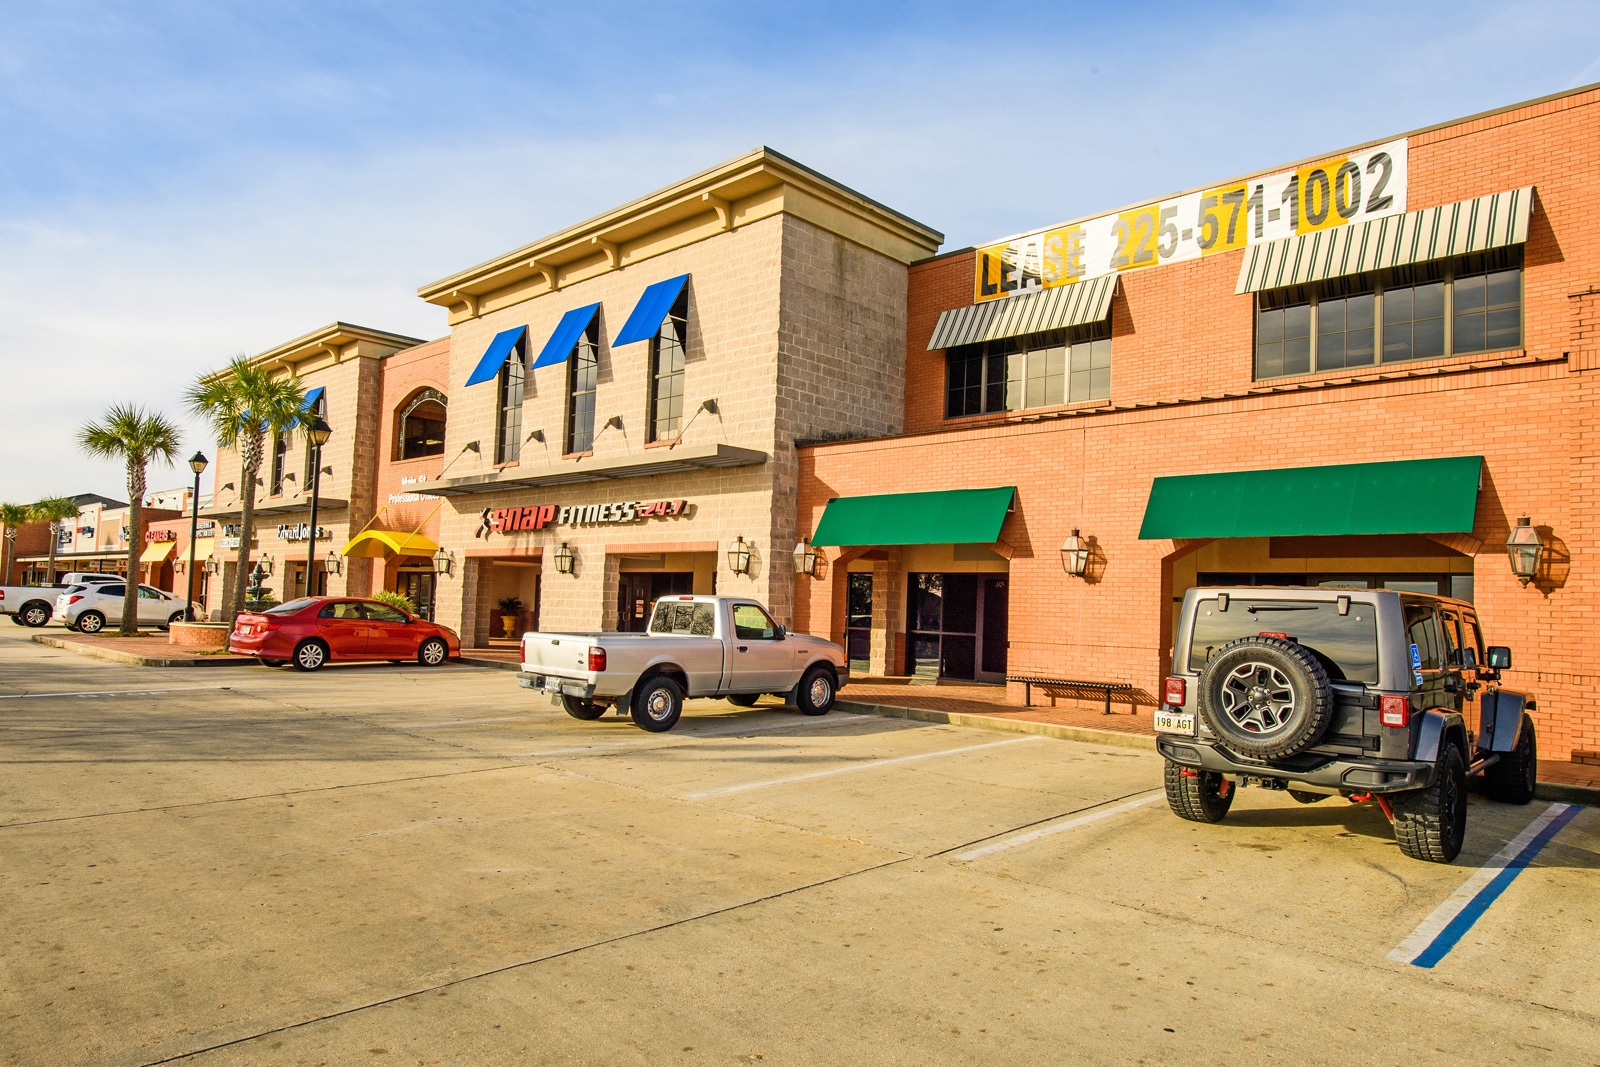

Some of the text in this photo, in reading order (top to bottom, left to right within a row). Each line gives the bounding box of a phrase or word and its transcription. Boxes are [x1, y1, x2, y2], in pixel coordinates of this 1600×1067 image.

[980, 153, 1394, 298] LEASE 225-571-1002
[557, 501, 636, 524] FITNESS
[145, 529, 168, 543] CLEANERS
[276, 522, 320, 541] Edward Jons
[1157, 717, 1192, 730] 198 AGT
